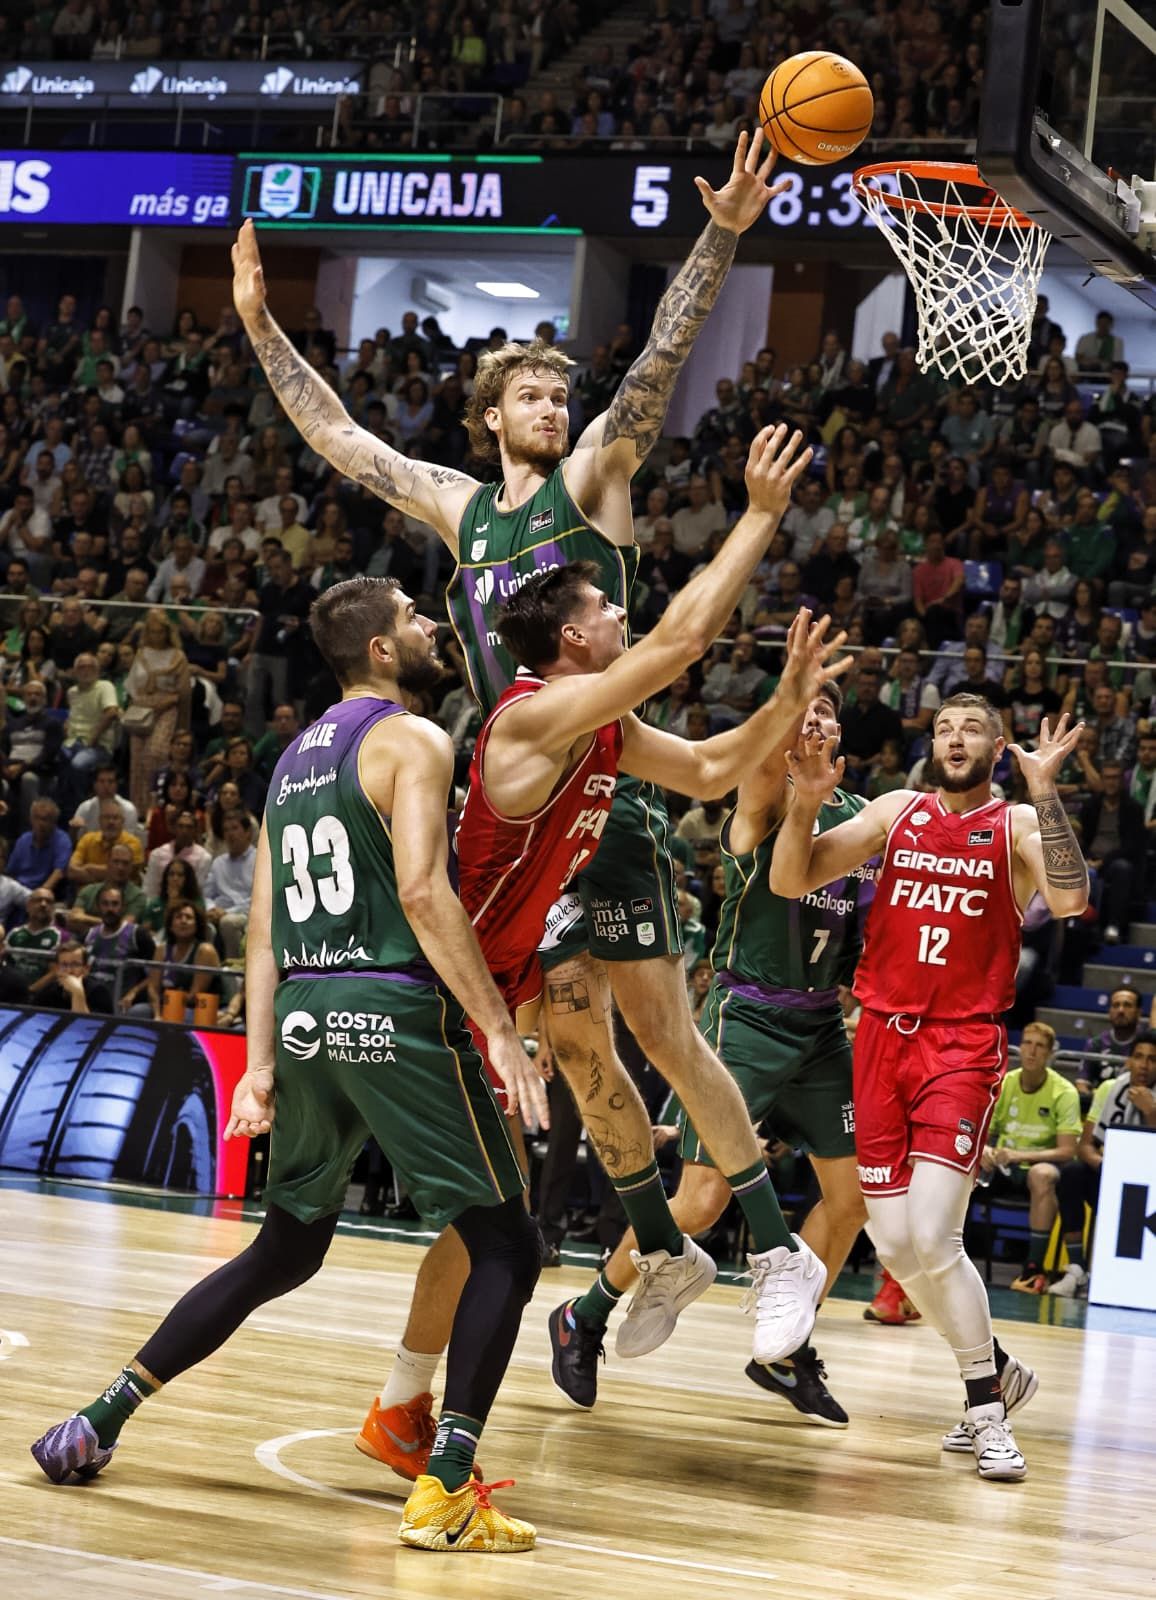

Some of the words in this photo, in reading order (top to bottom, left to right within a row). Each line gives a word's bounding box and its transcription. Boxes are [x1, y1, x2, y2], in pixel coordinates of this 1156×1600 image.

[32, 76, 94, 99] Unicaja
[162, 77, 227, 100] Unicaja
[129, 188, 190, 216] más
[333, 171, 503, 217] UNICAJA
[630, 166, 670, 228] 5
[281, 815, 355, 923] 33
[892, 849, 995, 880] GIRONA
[889, 878, 989, 917] FIATC
[809, 929, 831, 964] 7
[917, 925, 950, 966] 12
[326, 1011, 396, 1033] COSTA
[326, 1031, 355, 1047] DEL
[359, 1033, 396, 1048] SOL
[327, 1045, 396, 1063] MÁLAGA
[843, 1119, 857, 1133] la
